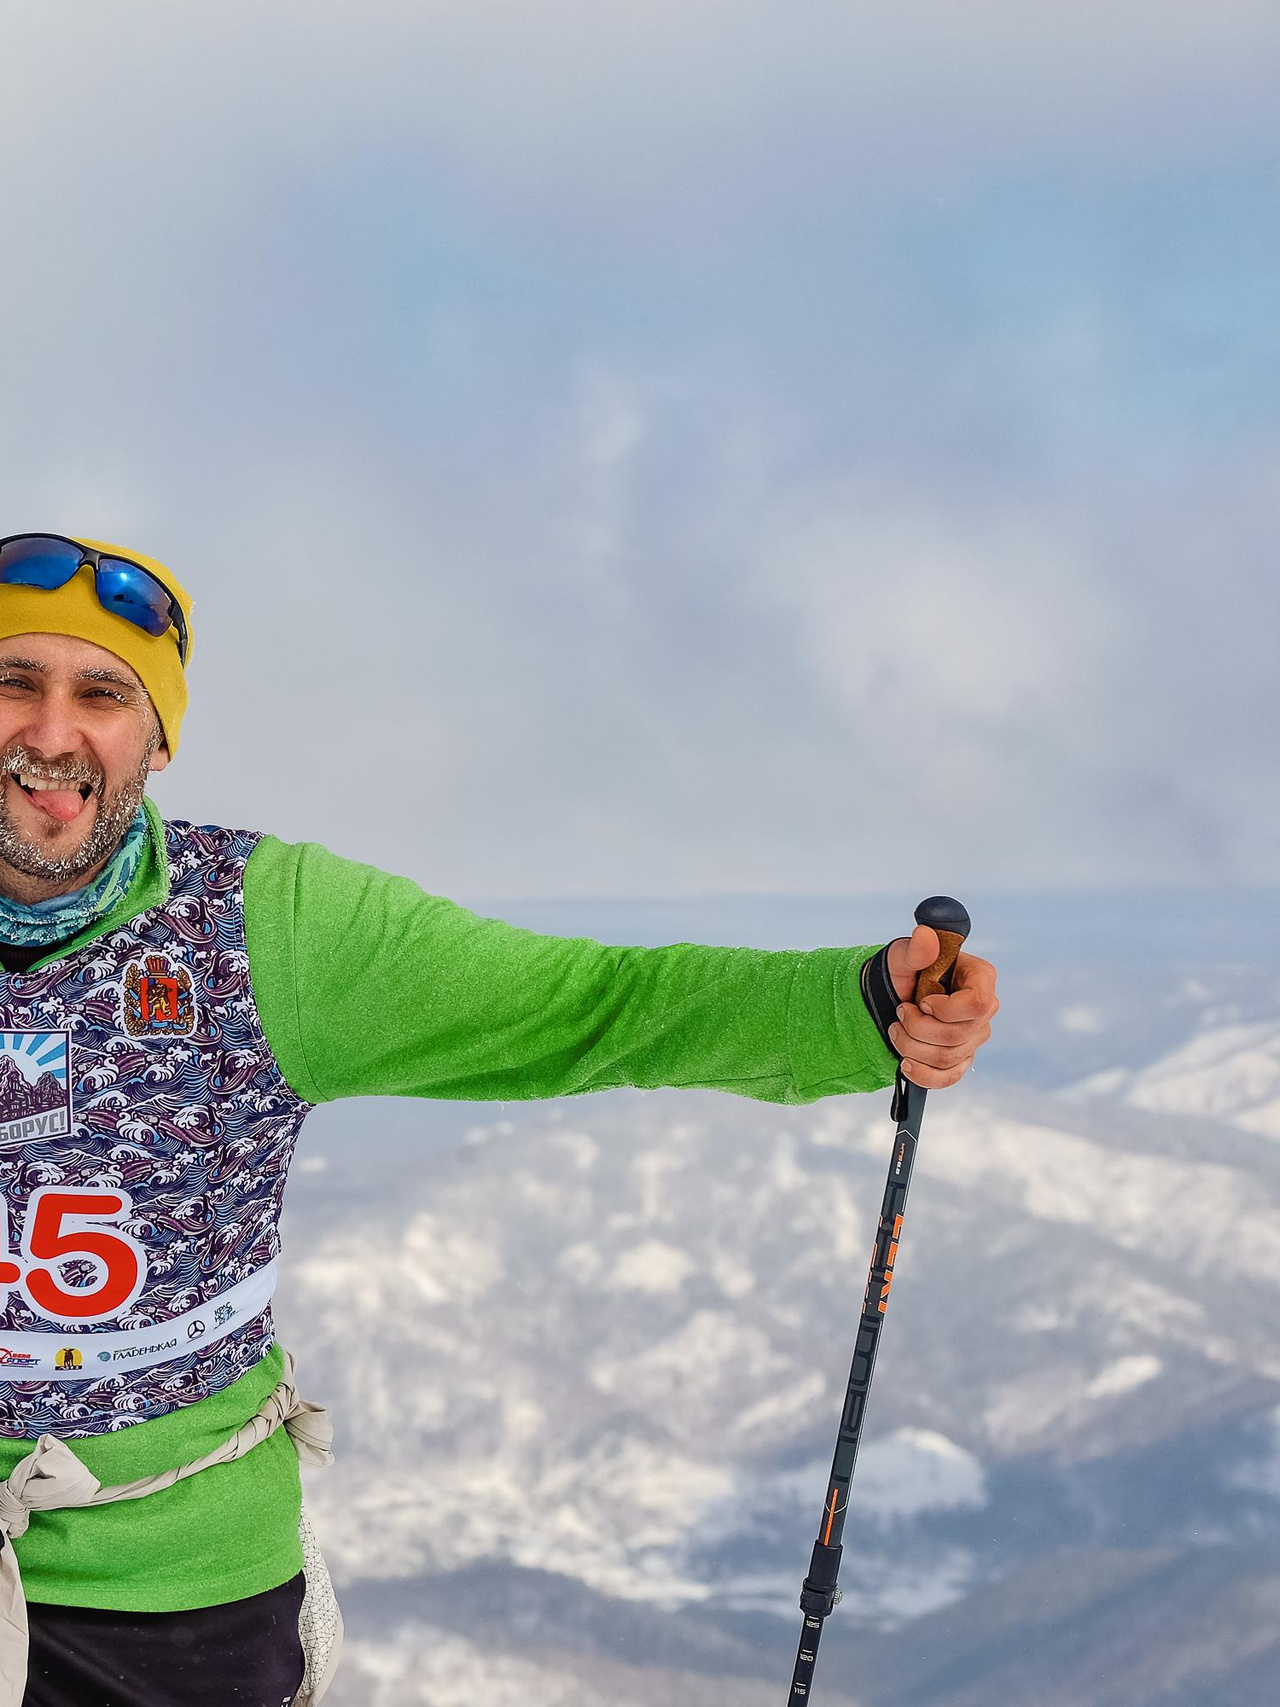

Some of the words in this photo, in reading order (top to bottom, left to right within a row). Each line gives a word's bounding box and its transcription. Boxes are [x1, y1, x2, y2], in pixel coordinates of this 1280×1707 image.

[806, 1620, 820, 1629] 125
[799, 1653, 814, 1662] 120
[793, 1686, 806, 1695] 115
